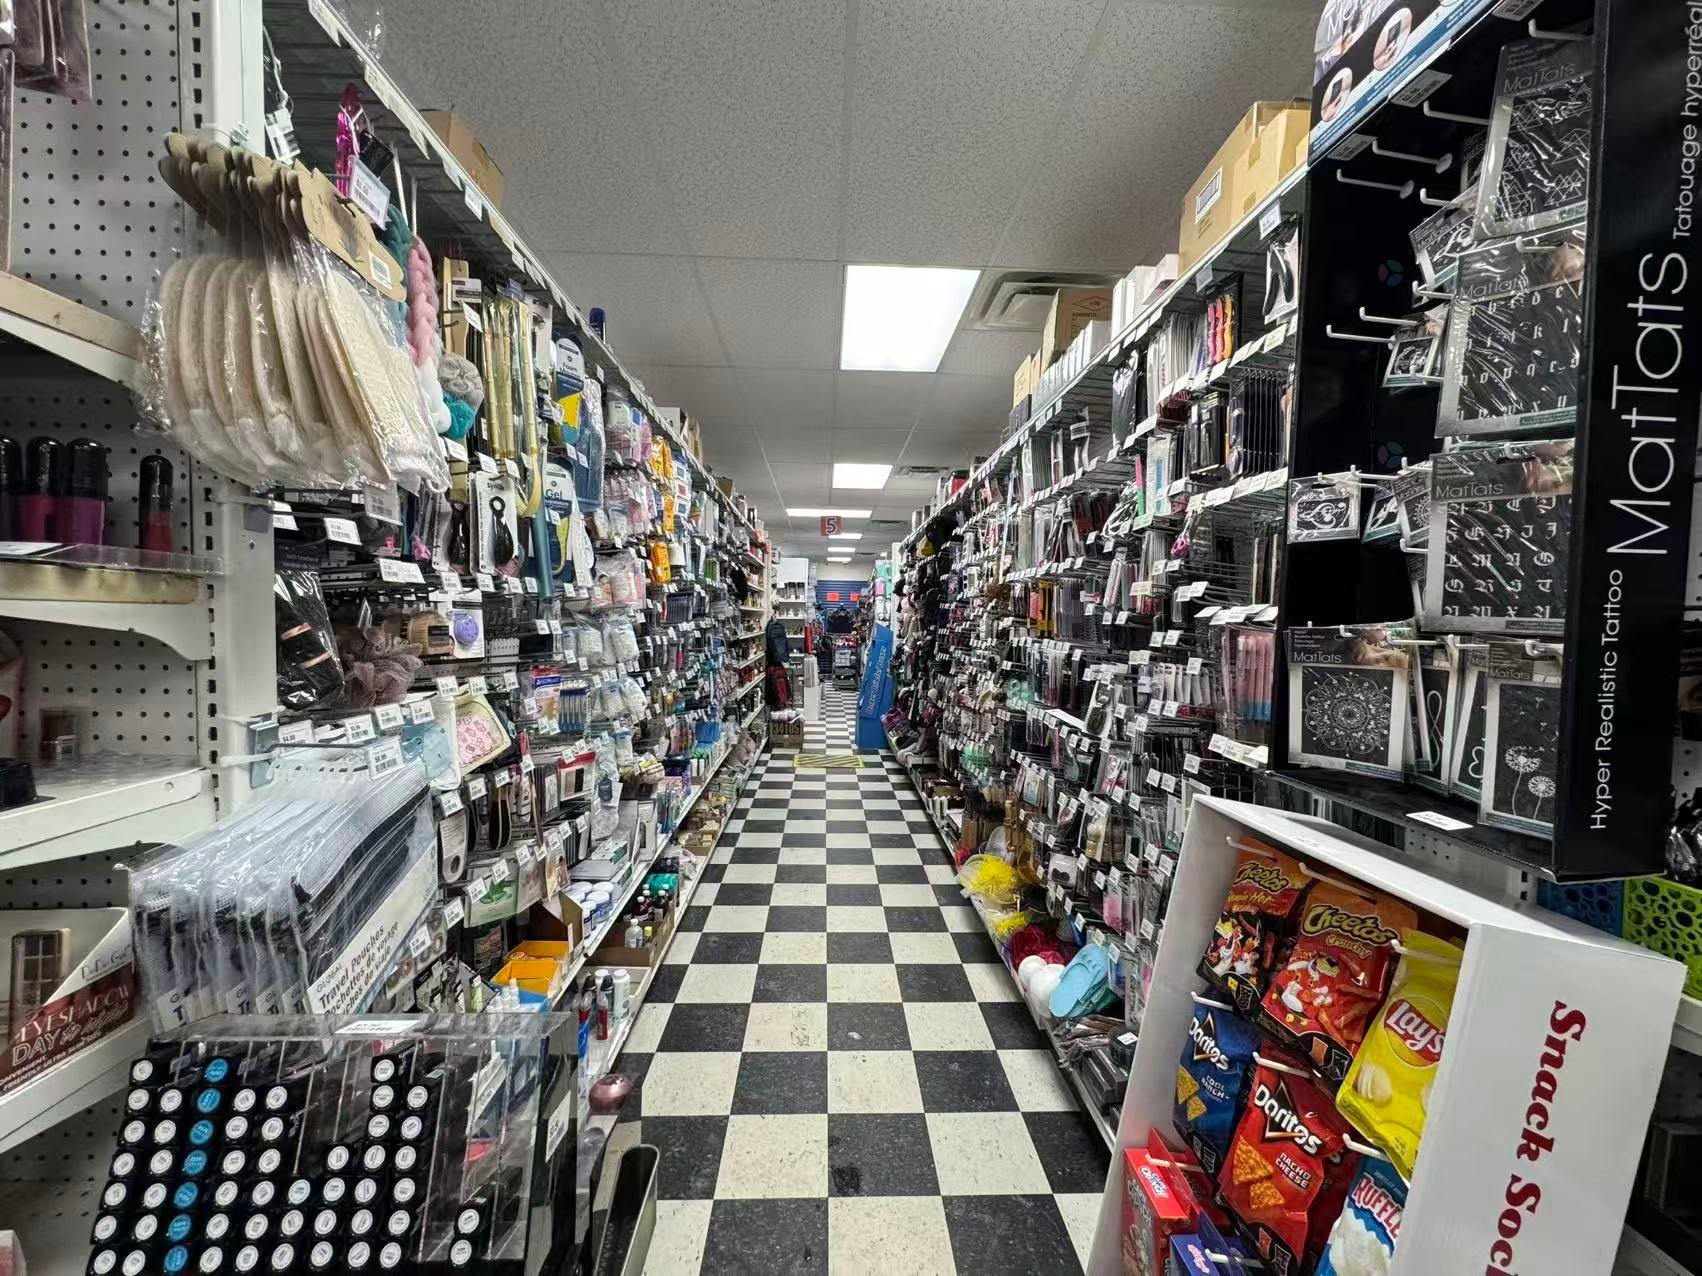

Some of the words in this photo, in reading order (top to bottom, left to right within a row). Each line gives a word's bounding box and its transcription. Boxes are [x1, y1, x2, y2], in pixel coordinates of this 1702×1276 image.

[1672, 124, 1700, 239] Tatouage
[1606, 252, 1688, 555] MatTats
[545, 485, 563, 498] Gel
[1436, 481, 1504, 498] MatTats
[824, 518, 838, 535] 5
[1601, 569, 1624, 646] Tattoo
[1294, 650, 1342, 664] MatTats
[1490, 668, 1530, 680] MatTats
[1595, 650, 1617, 751] Realistic
[1590, 758, 1613, 829] Hyper
[366, 952, 376, 968] de
[376, 920, 399, 952] voyage
[1302, 903, 1400, 945] Cheetos
[319, 971, 350, 1010] Travel
[350, 924, 385, 969] Pouches
[1326, 935, 1373, 959] Crunchy
[12, 1028, 62, 1067] DAY
[1189, 1017, 1230, 1071] Doritos
[1516, 1000, 1587, 1162] Snack
[1254, 1085, 1323, 1154] Doritos
[1275, 1158, 1309, 1188] CHEESE
[1279, 1153, 1310, 1180] NACHO
